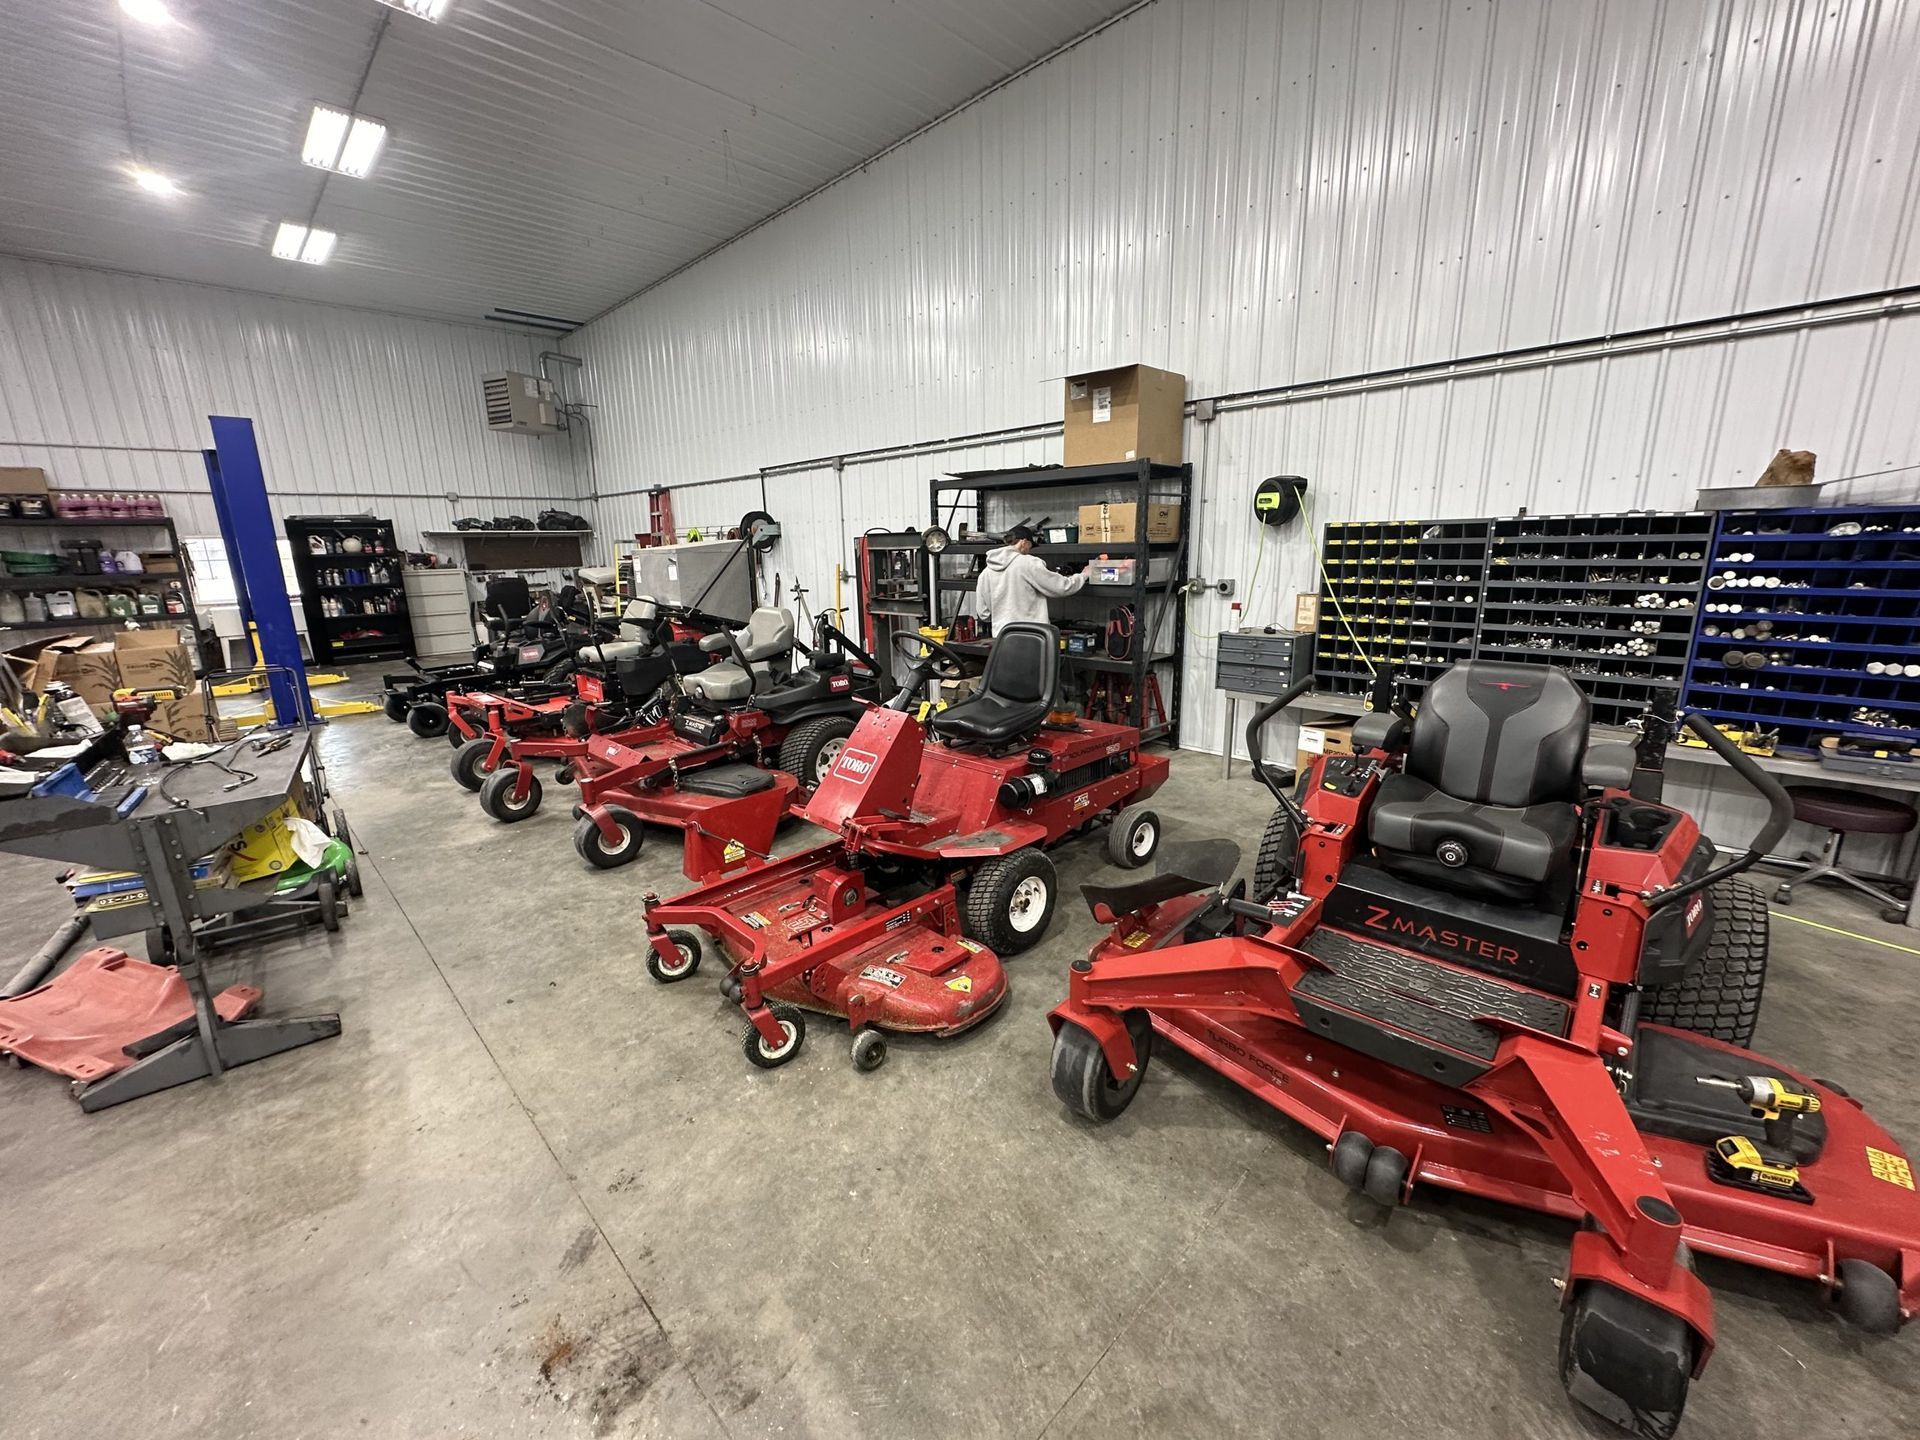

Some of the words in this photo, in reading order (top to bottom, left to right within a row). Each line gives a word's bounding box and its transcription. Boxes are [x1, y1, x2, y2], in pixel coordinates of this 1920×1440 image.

[832, 679, 849, 688] TORO
[841, 756, 870, 774] TORO
[1364, 904, 1390, 931] Z
[1391, 915, 1520, 966] MASTER
[1206, 1029, 1247, 1057] TURBO
[1248, 1054, 1290, 1084] FORCE
